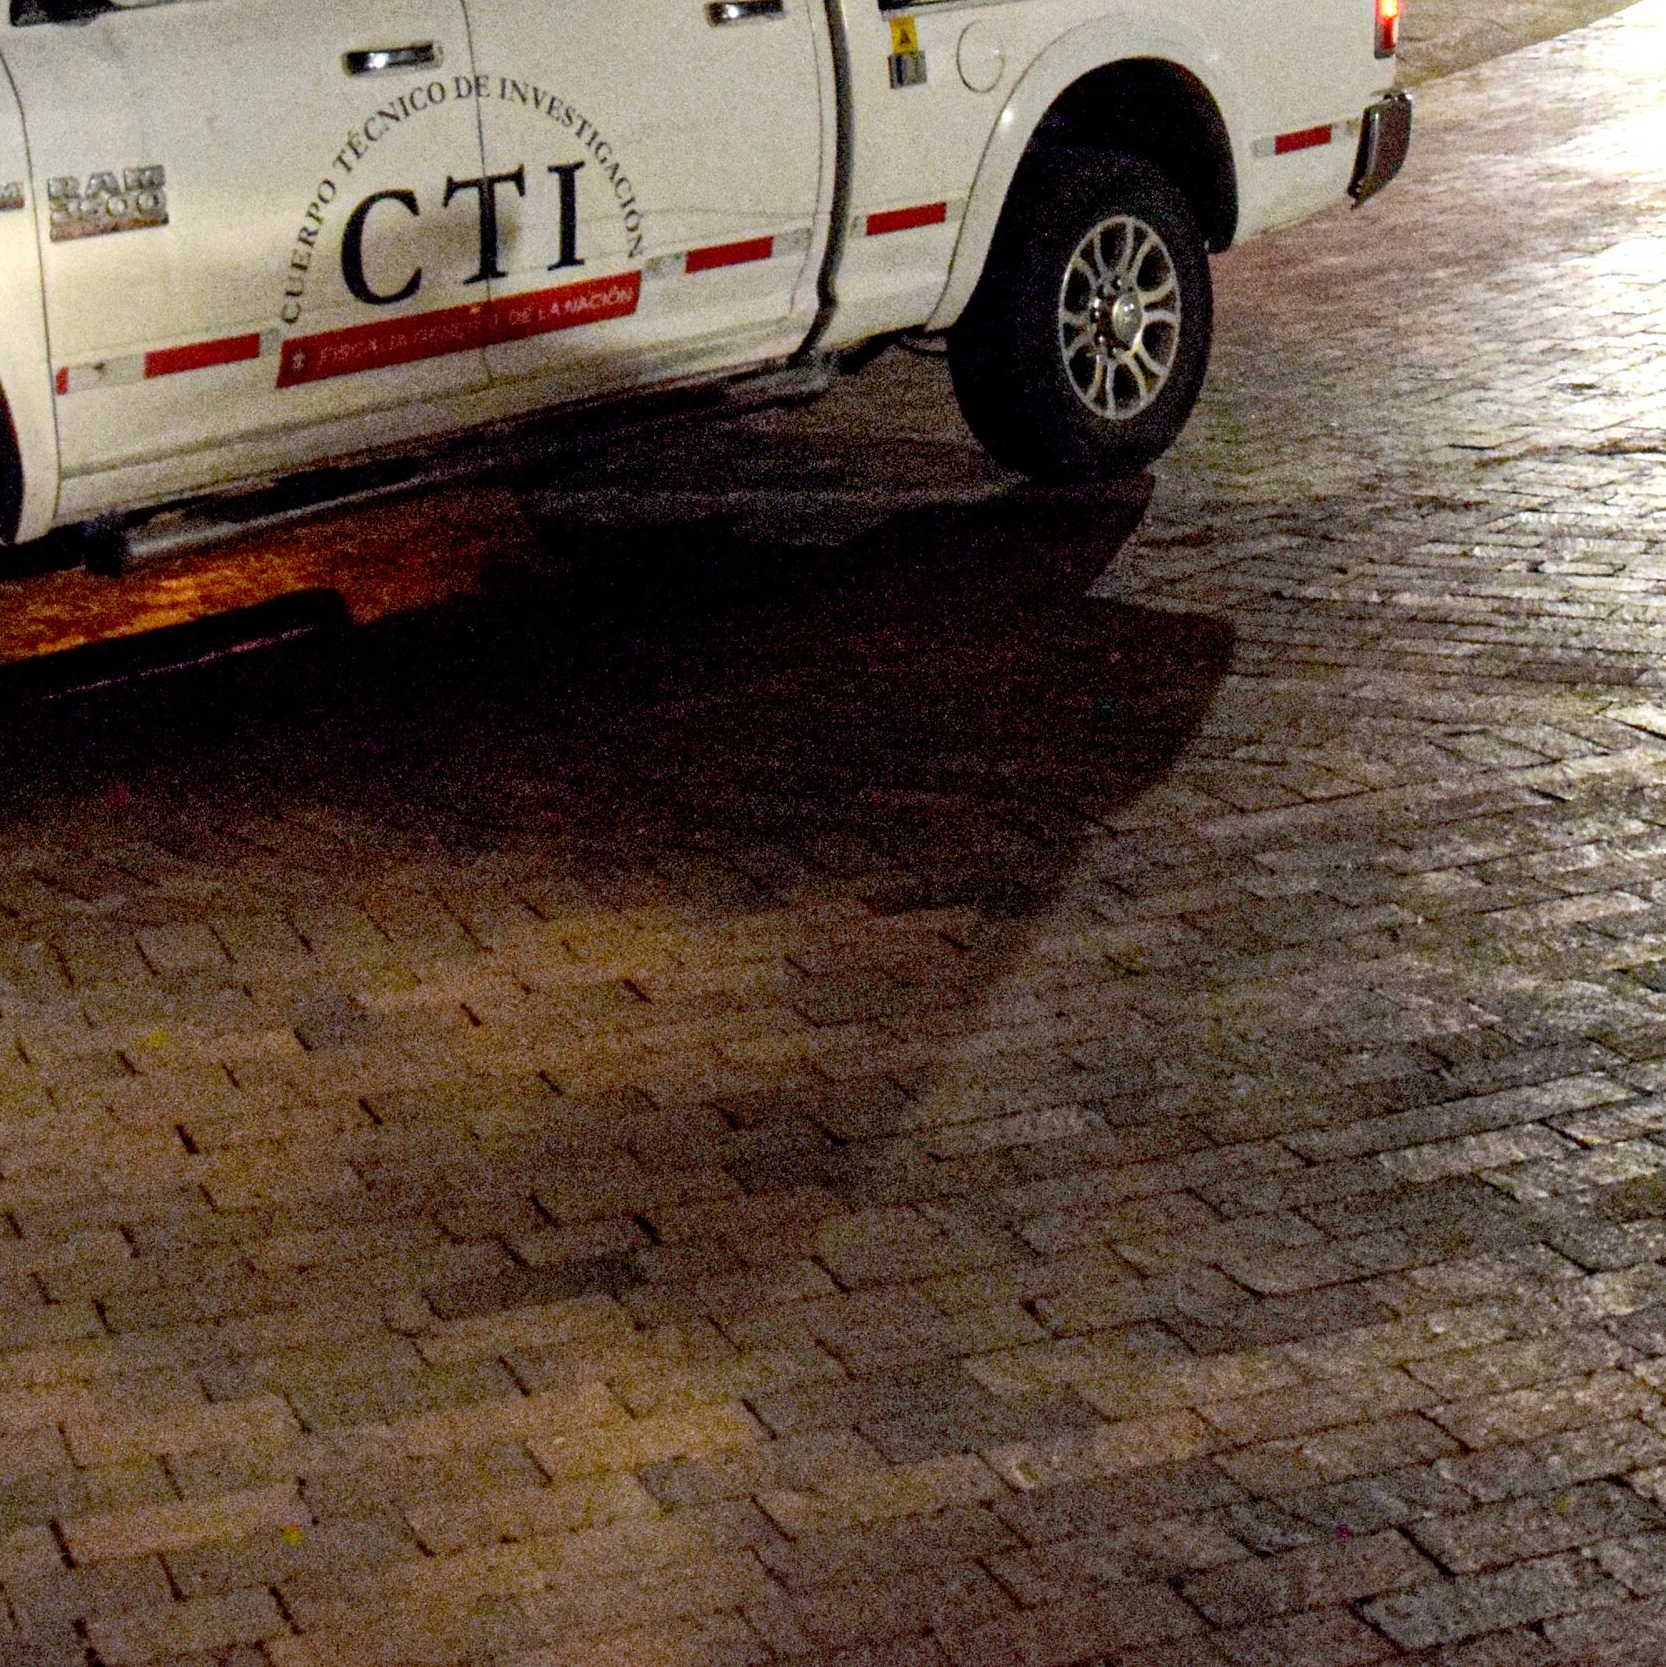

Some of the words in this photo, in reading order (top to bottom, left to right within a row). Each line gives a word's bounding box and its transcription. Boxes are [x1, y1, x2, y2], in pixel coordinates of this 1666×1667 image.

[47, 164, 167, 202] RAM
[281, 178, 337, 325] CUERPO
[453, 74, 491, 100] DE
[340, 161, 585, 306] CTI
[537, 301, 561, 322] LA
[564, 285, 634, 315] NACIÓN
